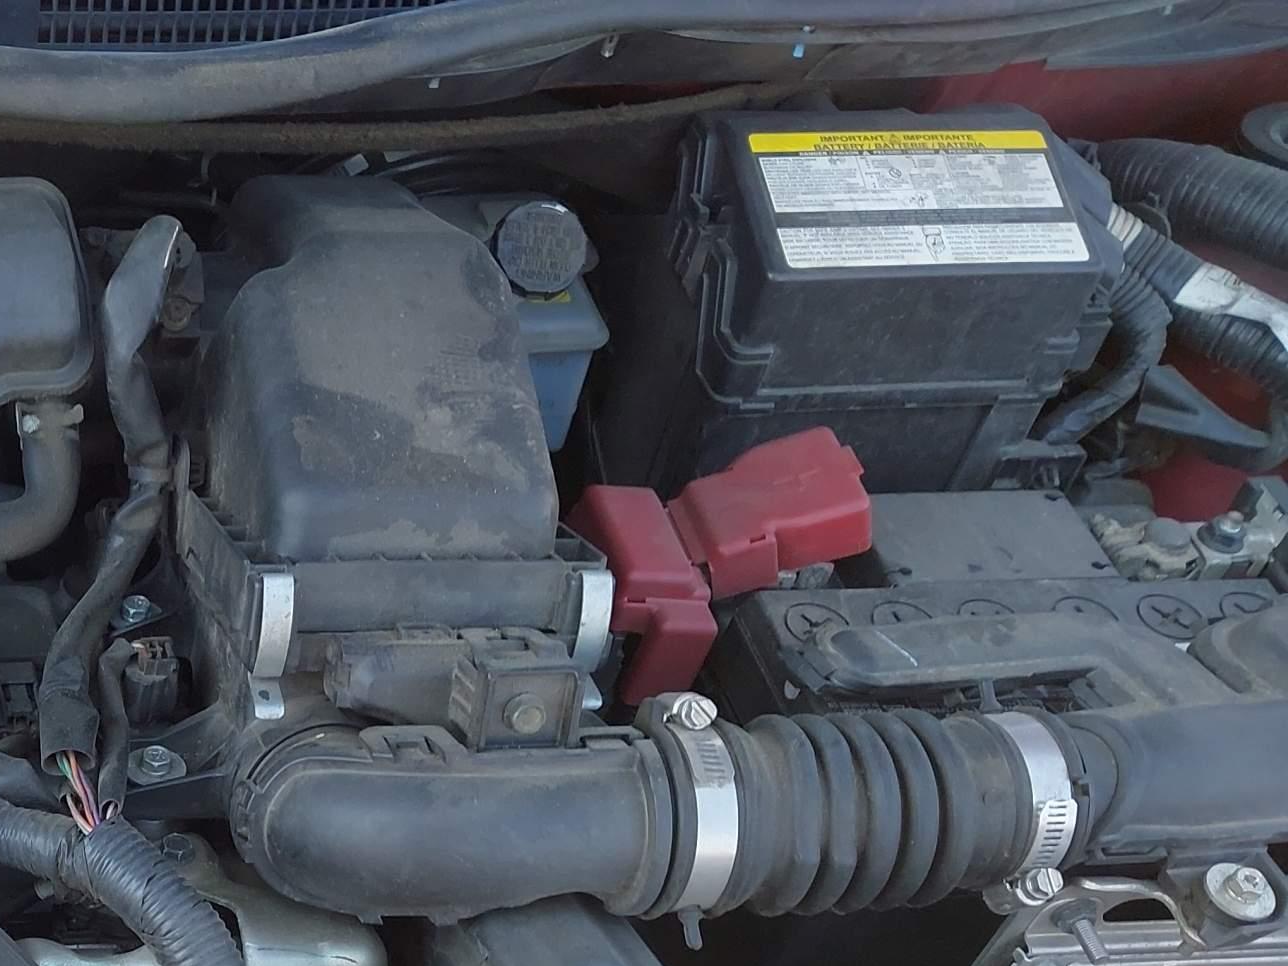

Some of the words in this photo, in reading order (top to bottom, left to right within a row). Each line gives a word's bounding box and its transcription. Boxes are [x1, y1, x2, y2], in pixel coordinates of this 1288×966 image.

[819, 134, 885, 143] IMPORTANT
[902, 133, 973, 141] IMPORTANTE
[813, 143, 865, 151] BATTERY
[874, 142, 927, 150] BATTERIE
